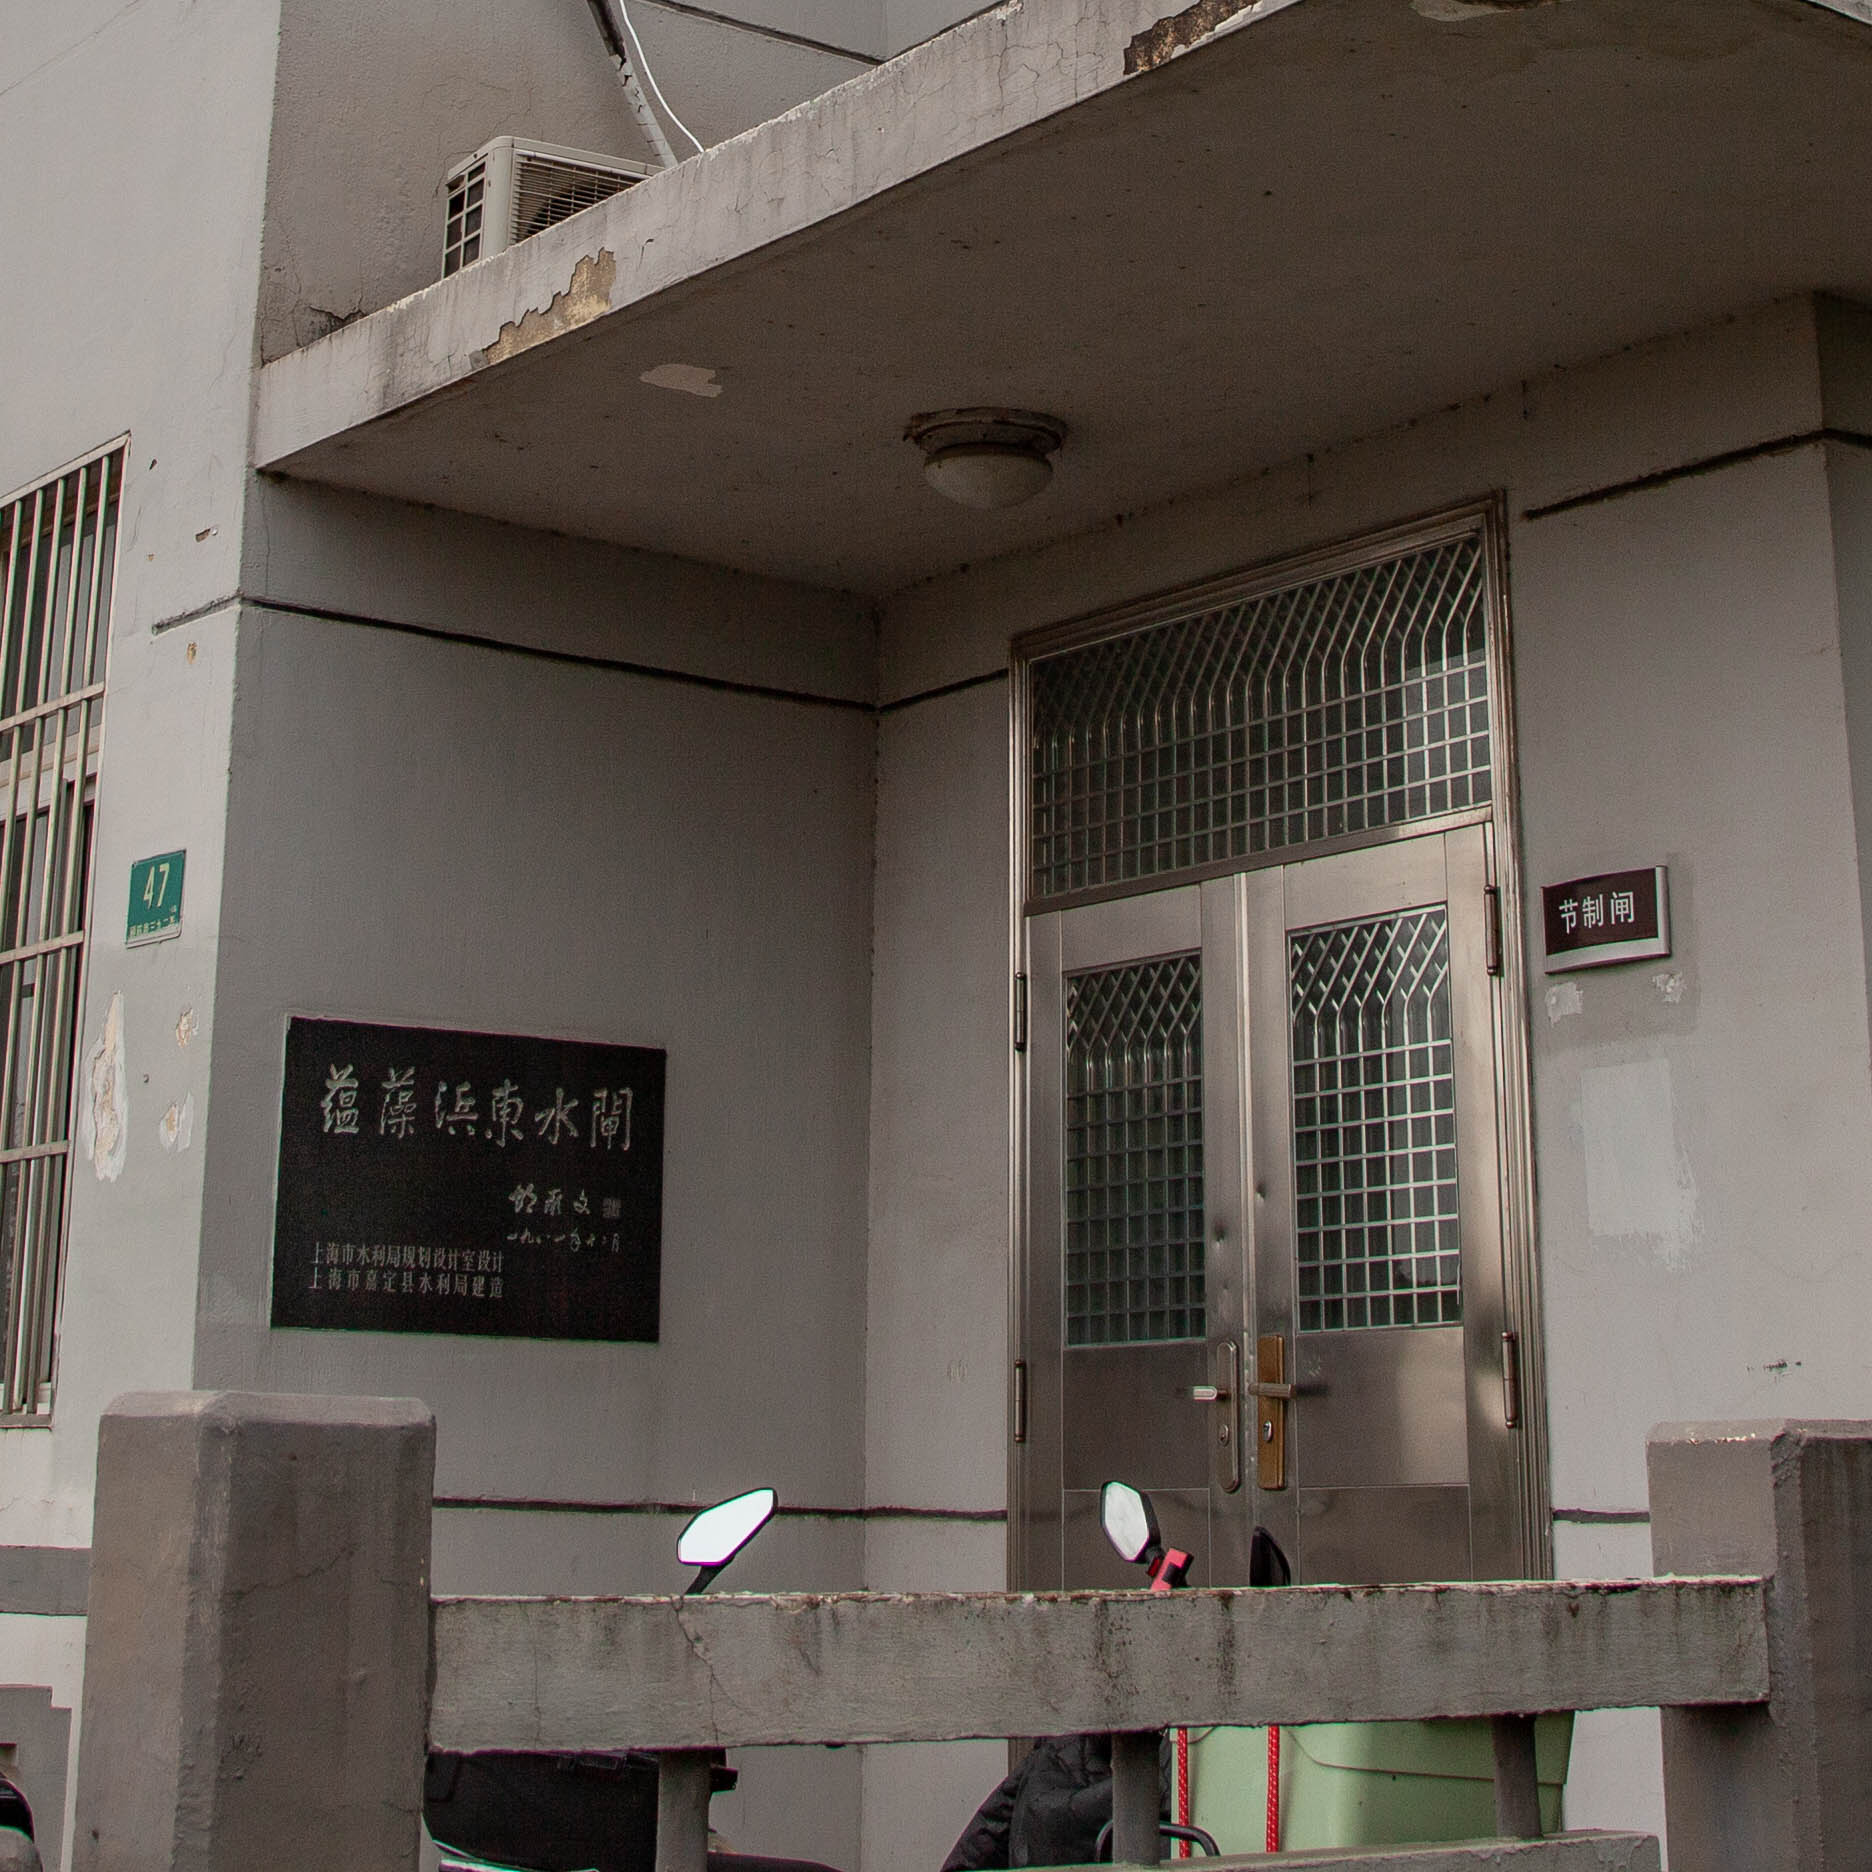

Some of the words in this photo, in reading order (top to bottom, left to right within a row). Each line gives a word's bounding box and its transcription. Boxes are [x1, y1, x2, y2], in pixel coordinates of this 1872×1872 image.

[143, 862, 170, 910] 47
[1558, 891, 1635, 934] 节制闸
[310, 1241, 505, 1273] 上海市水利局规划设计室设计
[308, 1266, 504, 1298] 上海市嘉定县水利局建造
